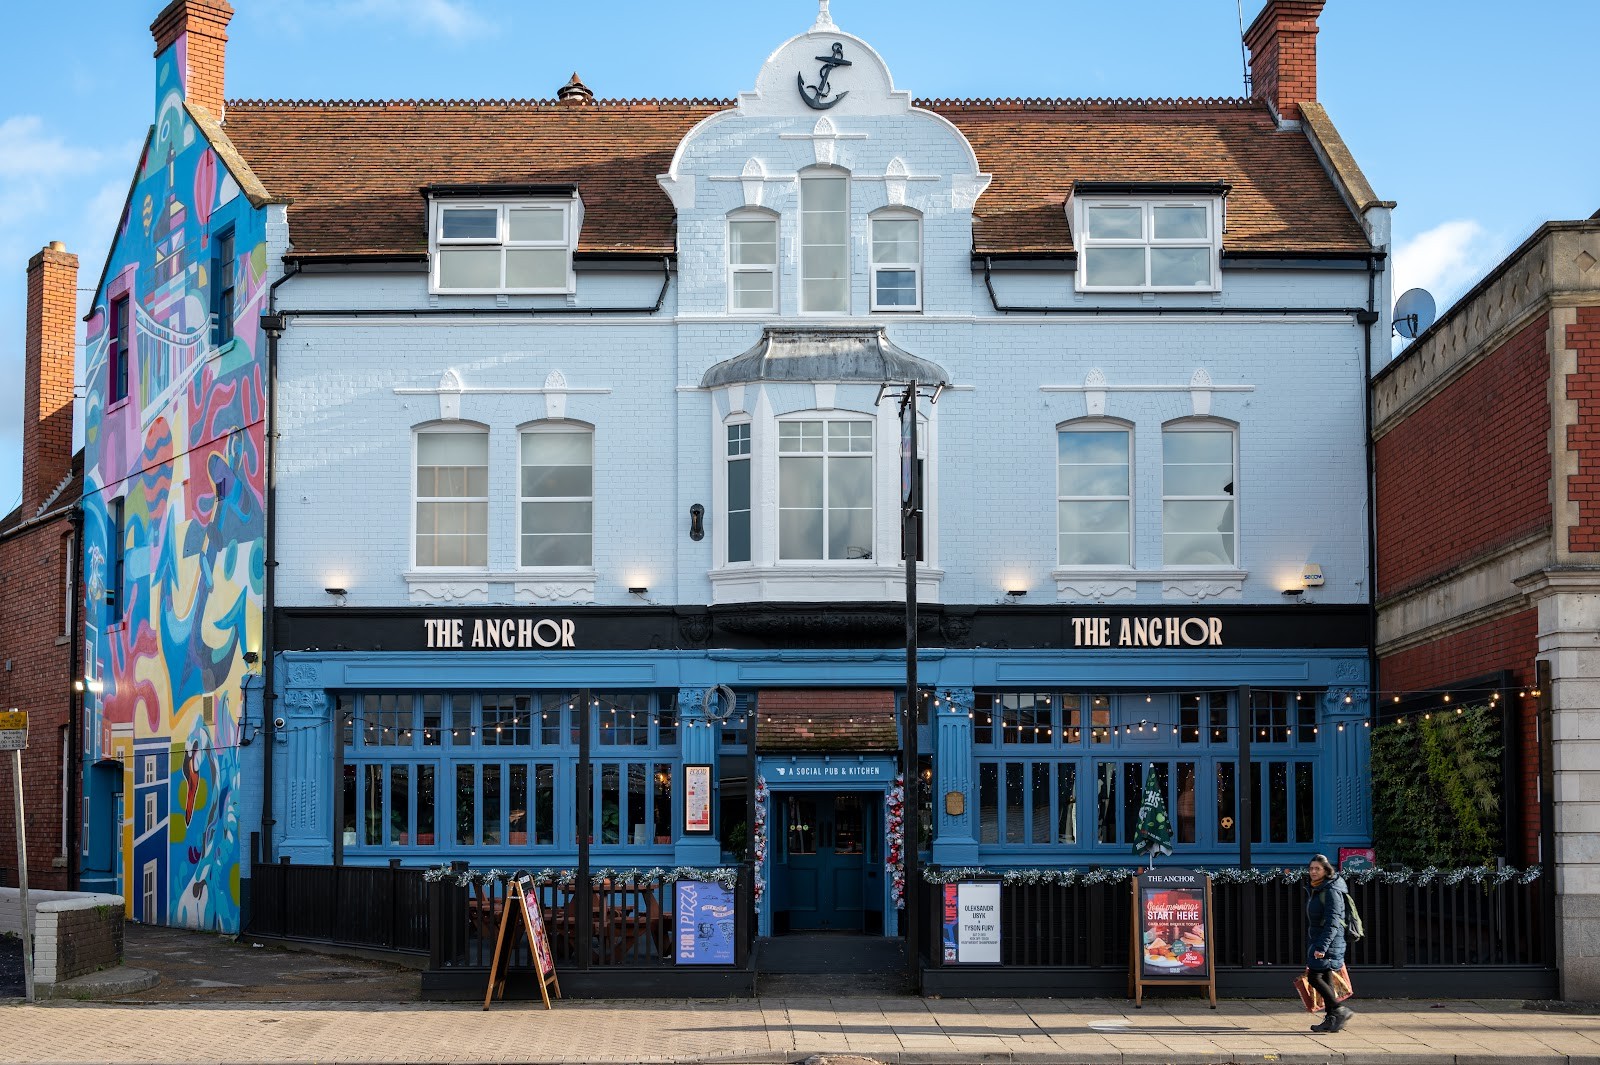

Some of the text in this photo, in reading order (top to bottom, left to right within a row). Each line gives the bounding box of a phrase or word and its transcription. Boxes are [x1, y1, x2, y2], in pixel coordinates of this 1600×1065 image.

[424, 618, 576, 648] THE ANCHOR
[1071, 617, 1223, 646] THE ANCHOR
[789, 766, 880, 775] A SOCIAL PUB & KITCHEN
[945, 884, 957, 905] SPORT
[681, 884, 698, 926] PIZZA
[1147, 901, 1199, 912] Good mornings
[1147, 911, 1199, 920] START HERE
[681, 934, 695, 951] FOR
